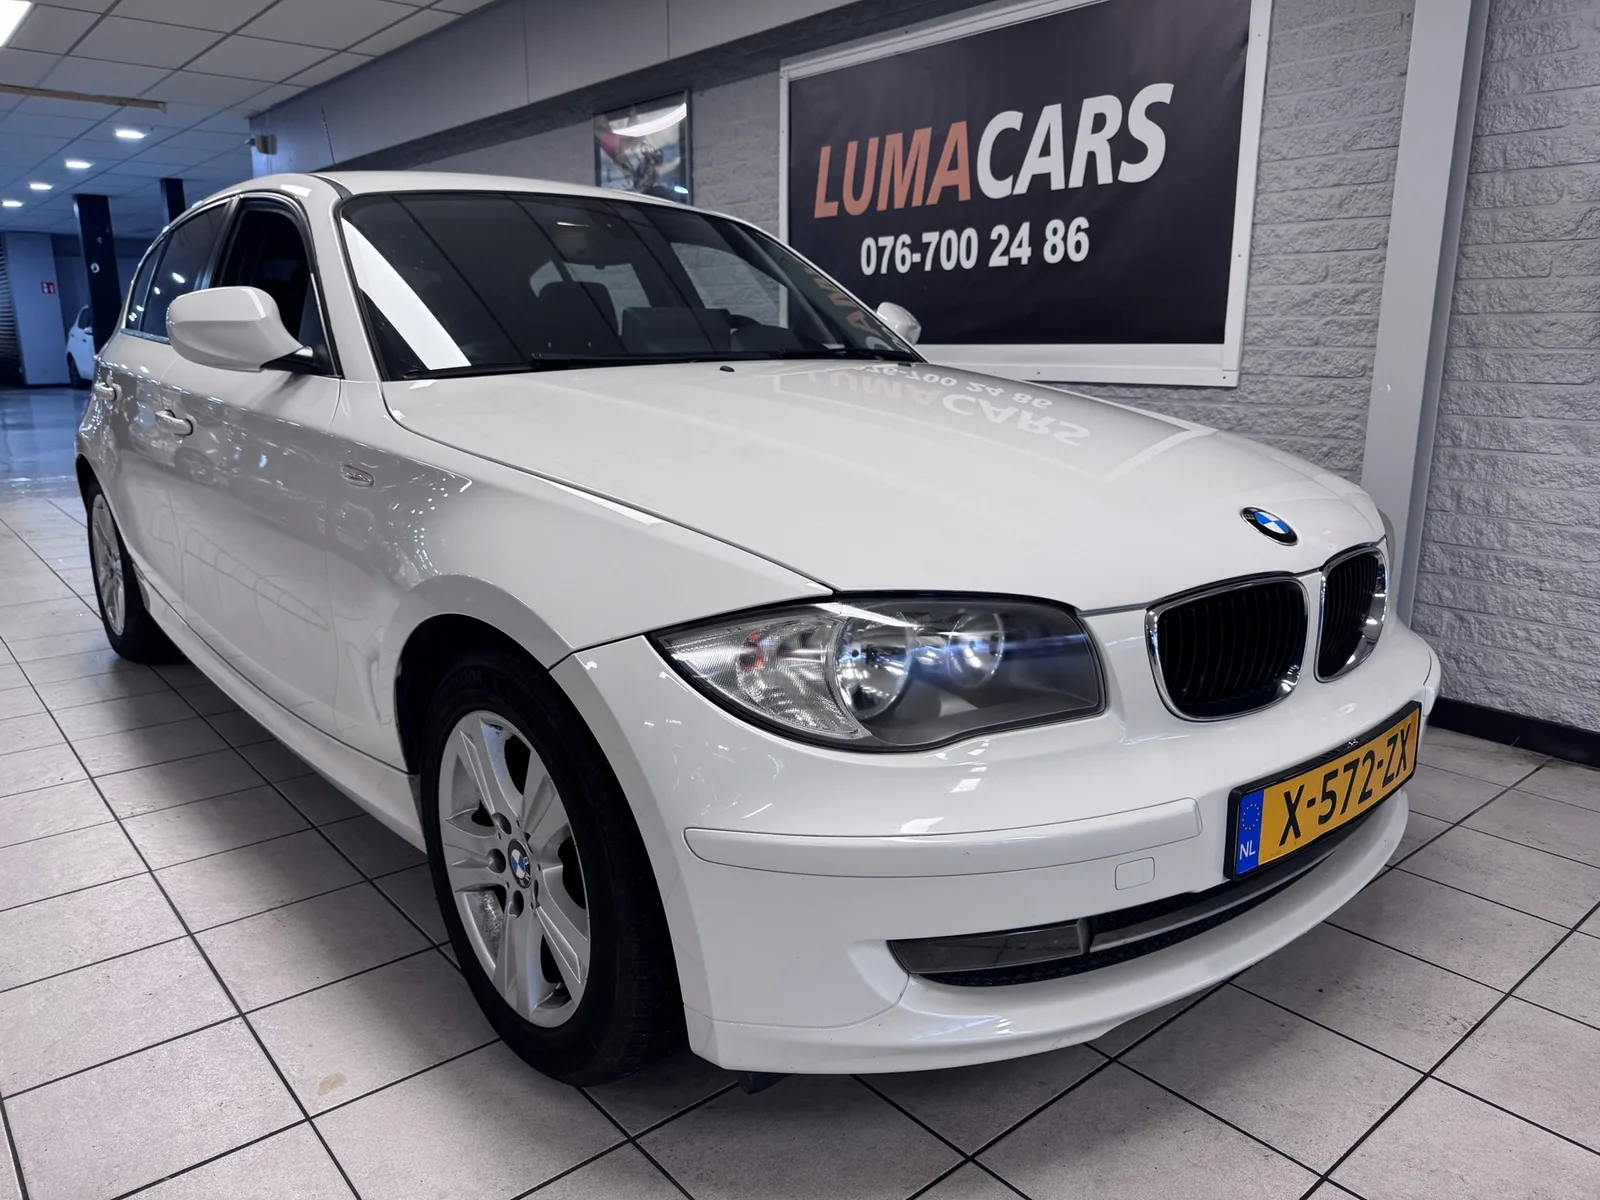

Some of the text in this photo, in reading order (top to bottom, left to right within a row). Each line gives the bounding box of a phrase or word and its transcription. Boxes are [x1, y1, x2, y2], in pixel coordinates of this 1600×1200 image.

[813, 83, 1175, 219] LUMACARS
[860, 216, 1091, 276] 076-700 24 86
[1278, 722, 1412, 847] X-572-ZX
[1238, 839, 1257, 861] NL
